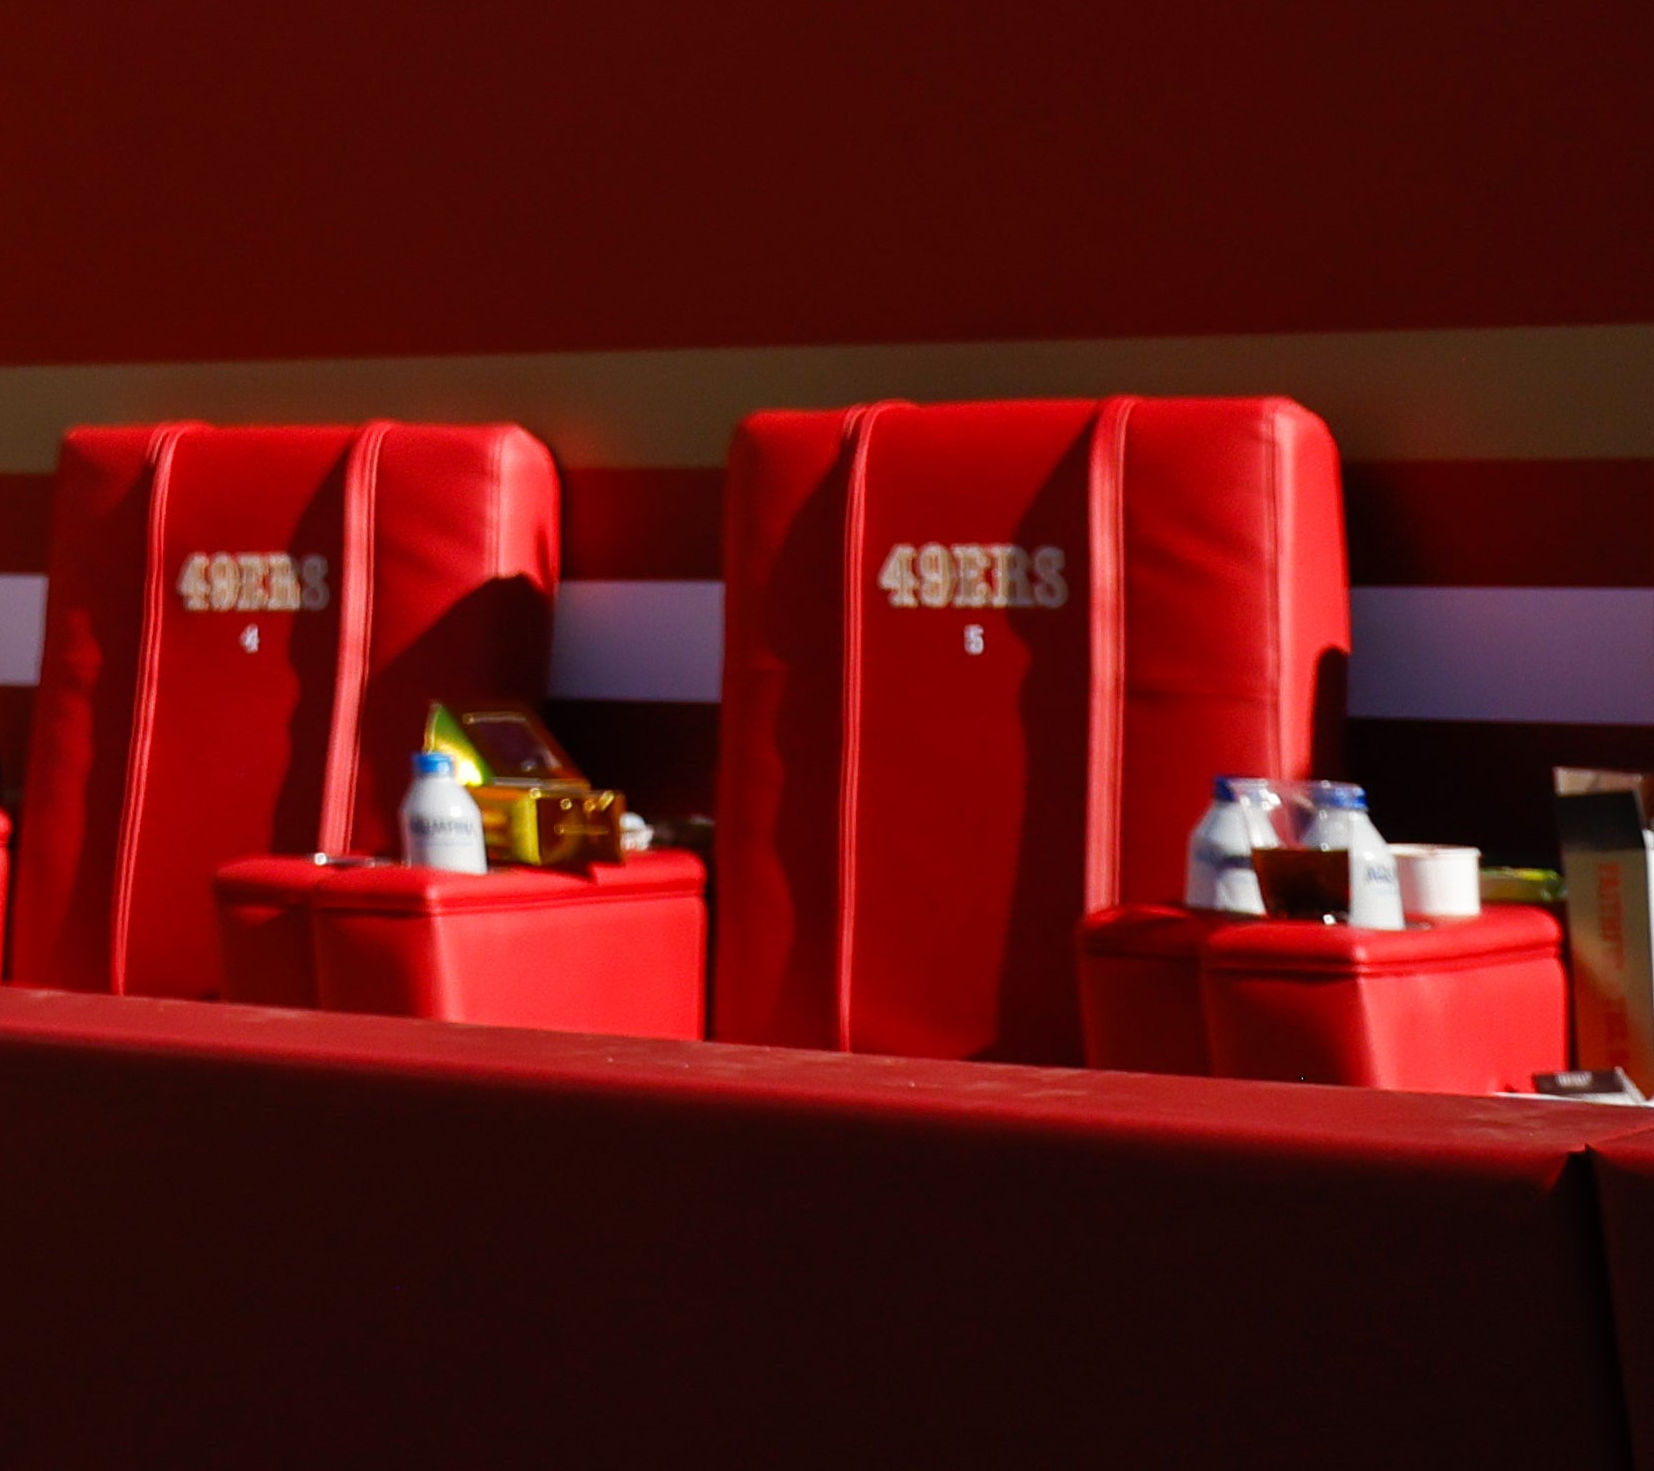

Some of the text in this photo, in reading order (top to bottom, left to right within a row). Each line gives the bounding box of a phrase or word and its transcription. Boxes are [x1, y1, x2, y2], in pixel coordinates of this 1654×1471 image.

[176, 551, 330, 611] 49ERS
[876, 541, 1069, 609] 49ERS
[963, 622, 985, 656] 5
